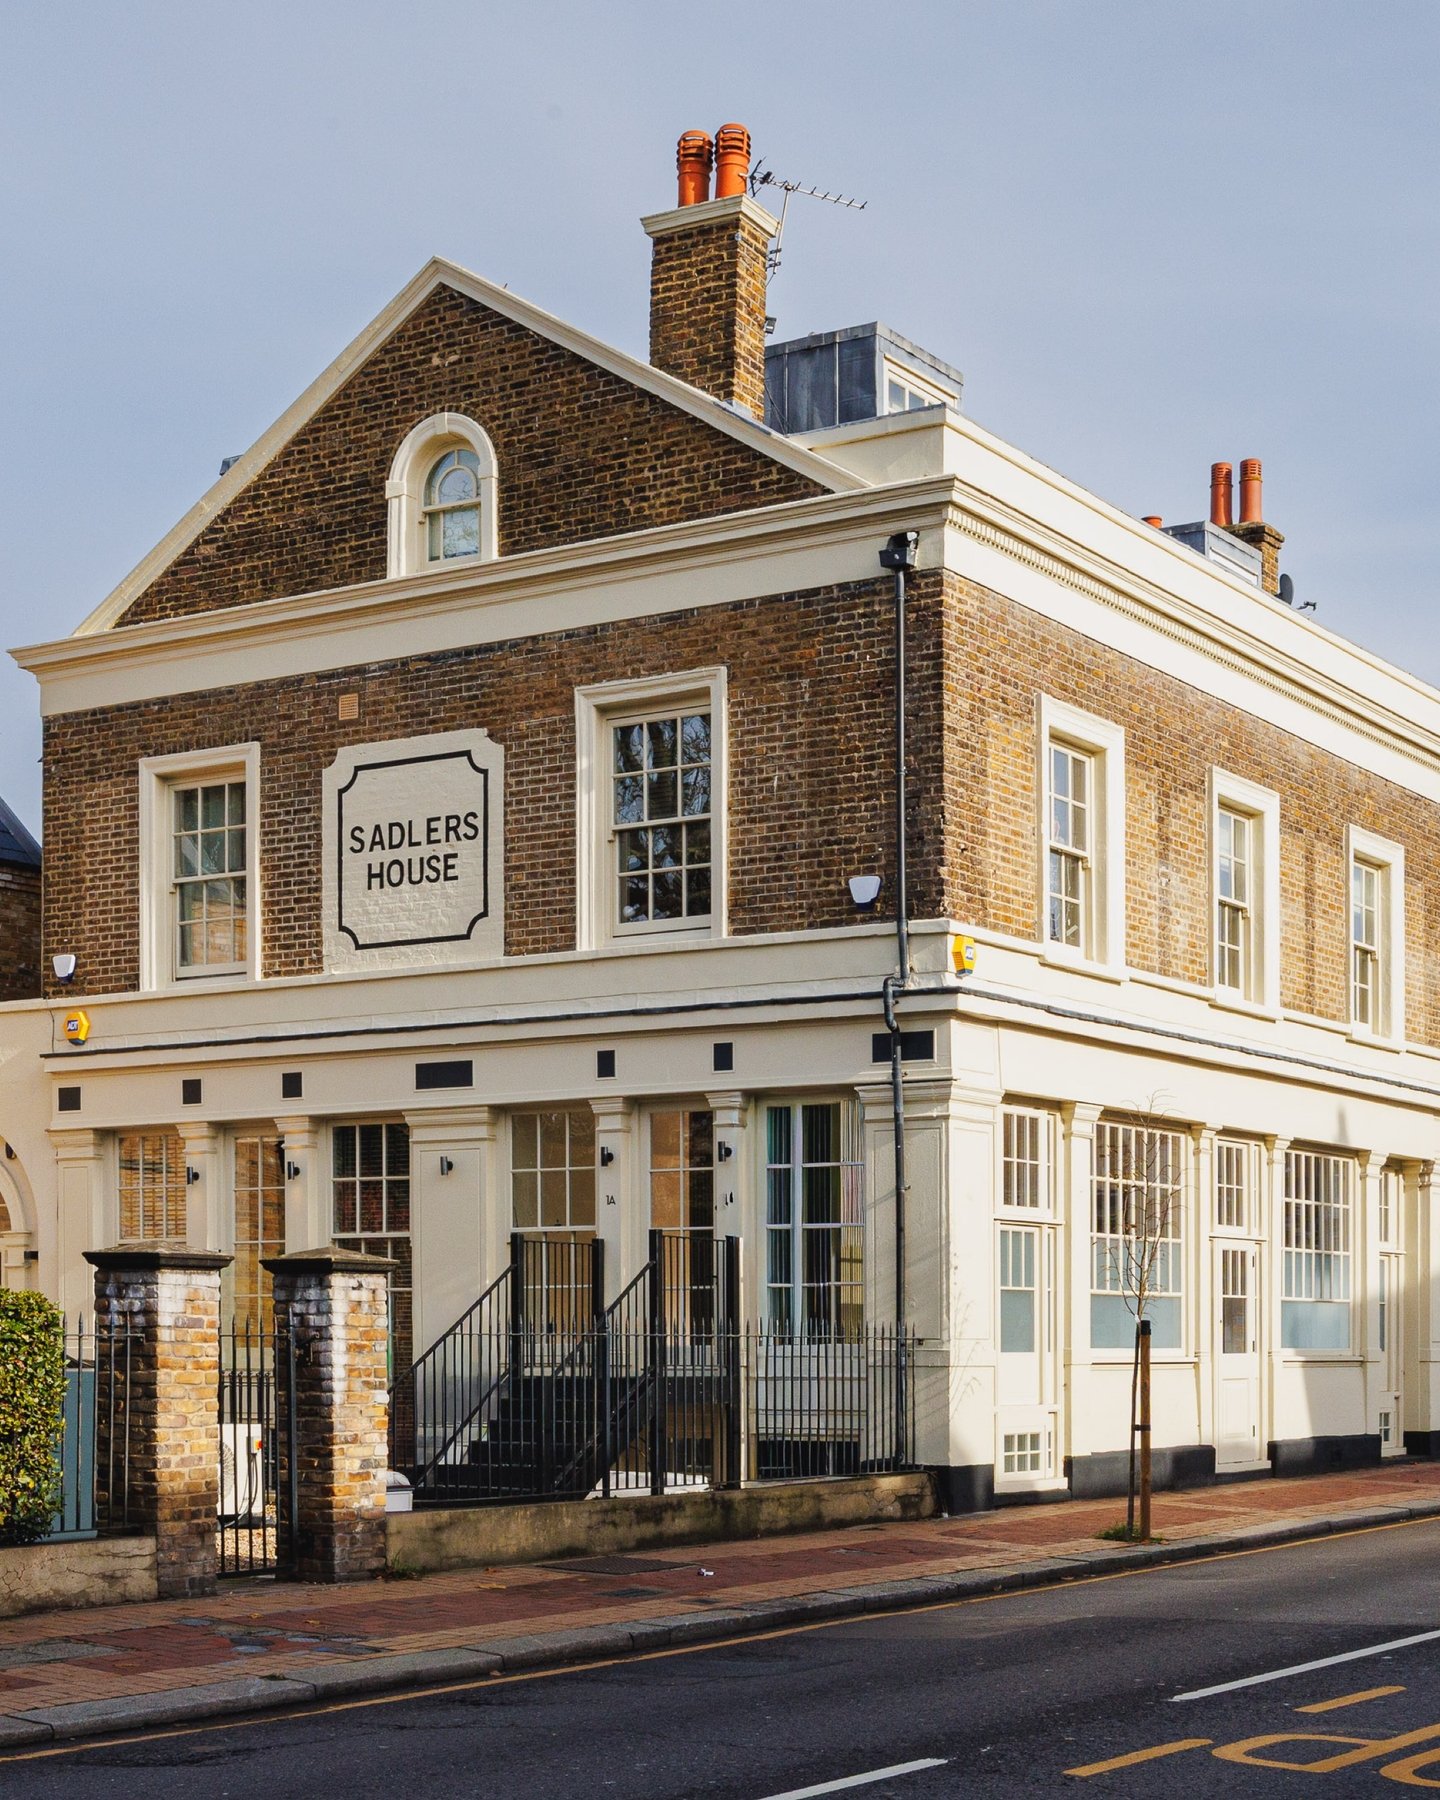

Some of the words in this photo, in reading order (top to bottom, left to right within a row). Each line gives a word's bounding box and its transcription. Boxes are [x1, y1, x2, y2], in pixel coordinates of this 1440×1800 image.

[349, 811, 479, 854] SADLERS
[367, 852, 459, 890] HOUSE
[605, 1194, 617, 1206] 1A
